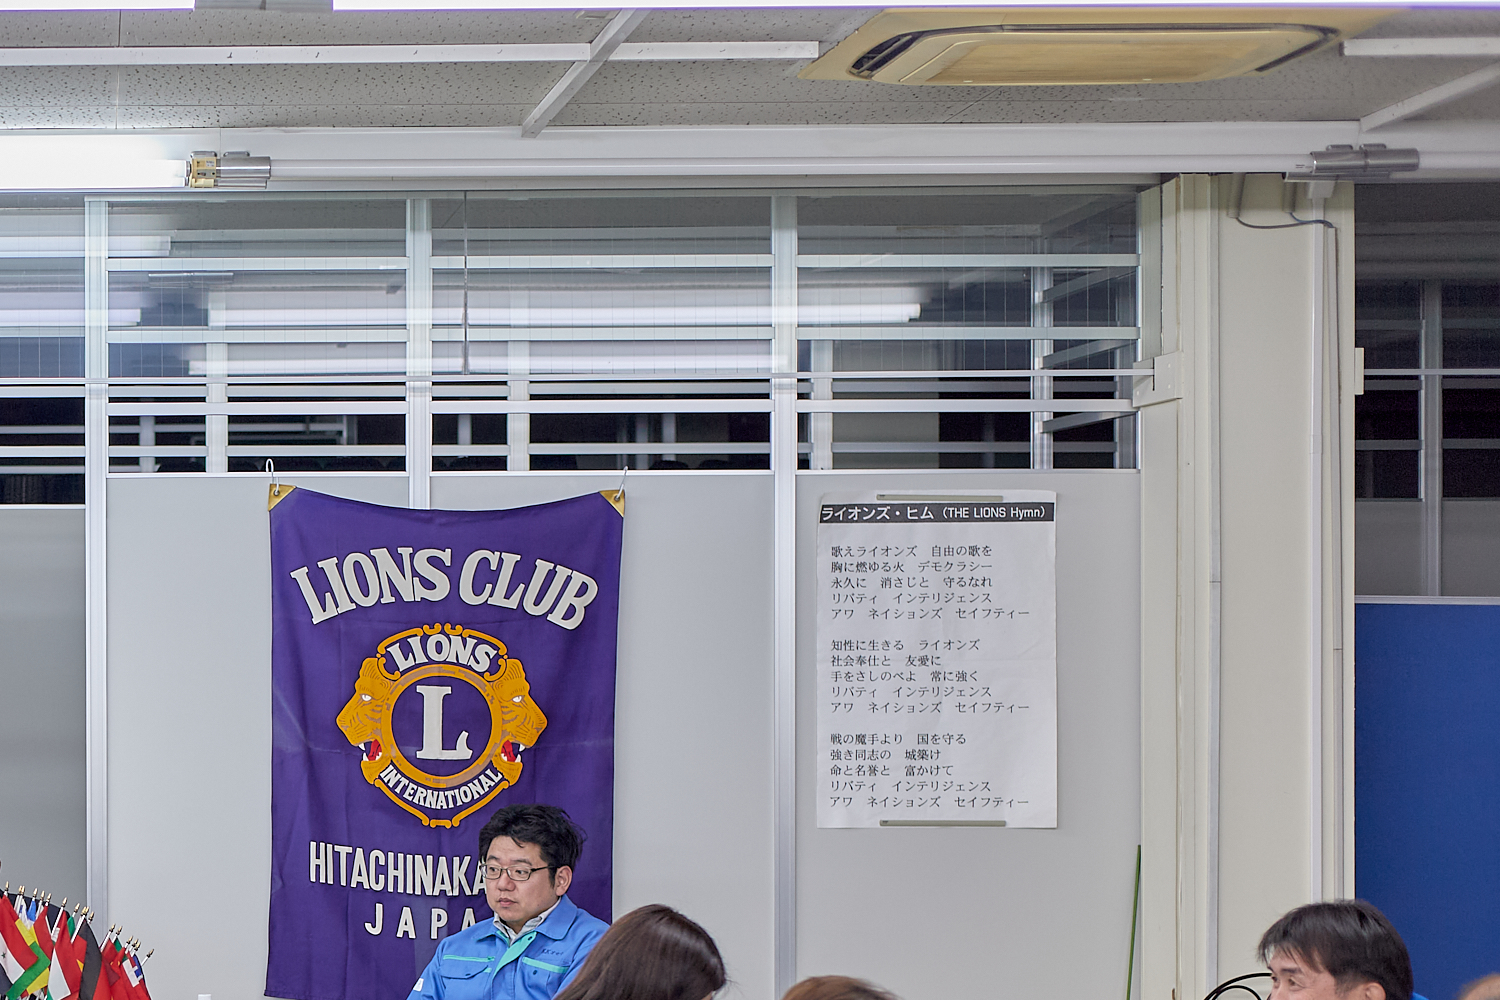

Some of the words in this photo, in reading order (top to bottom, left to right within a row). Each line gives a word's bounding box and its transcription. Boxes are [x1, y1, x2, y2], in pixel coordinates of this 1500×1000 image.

[821, 506, 934, 521] ライオンズ・ヒム
[973, 506, 1006, 518] LIONS
[831, 544, 918, 558] 歌えライオンズ
[931, 544, 993, 558] 自由の歌を
[830, 560, 905, 574] 胸に燃ゆる火
[917, 560, 993, 573] デモクラシー
[290, 547, 452, 626] LIONS
[458, 549, 599, 631] CLUB
[830, 576, 867, 590] 永久に
[880, 576, 929, 589] 消さじと
[942, 575, 993, 589] 守るなれ
[832, 592, 878, 605] リバティ
[893, 592, 992, 605] インテリジェンス
[831, 608, 854, 620] アワ
[868, 607, 943, 620] ネイションズ
[955, 607, 1030, 620] セイフティー
[830, 638, 904, 652] 知性に生きる
[919, 638, 981, 652] ライオンズ
[387, 632, 498, 674] LIONS
[830, 654, 891, 668] 社会奉仕と
[905, 654, 942, 668] 友愛に
[830, 670, 917, 683] 手をさしのべよ
[929, 669, 978, 683] 常に強く
[832, 685, 877, 699] リバティ
[892, 685, 992, 699] インテリジェンス
[830, 701, 854, 714] アワ
[867, 700, 943, 714] ネイションズ
[954, 701, 1030, 714] セイフティー
[416, 685, 473, 760] L
[917, 732, 967, 746] 国を守る
[830, 748, 892, 762] 強き同志の
[830, 763, 890, 777] 命と名誉と
[379, 765, 503, 810] INTERNATIONAL
[831, 780, 876, 793] リバティ
[891, 780, 991, 793] インテリジェンス
[829, 796, 853, 808] アワ
[867, 795, 942, 808] ネイションズ
[954, 796, 1029, 809] セイフティー
[364, 903, 477, 940] JAPA
